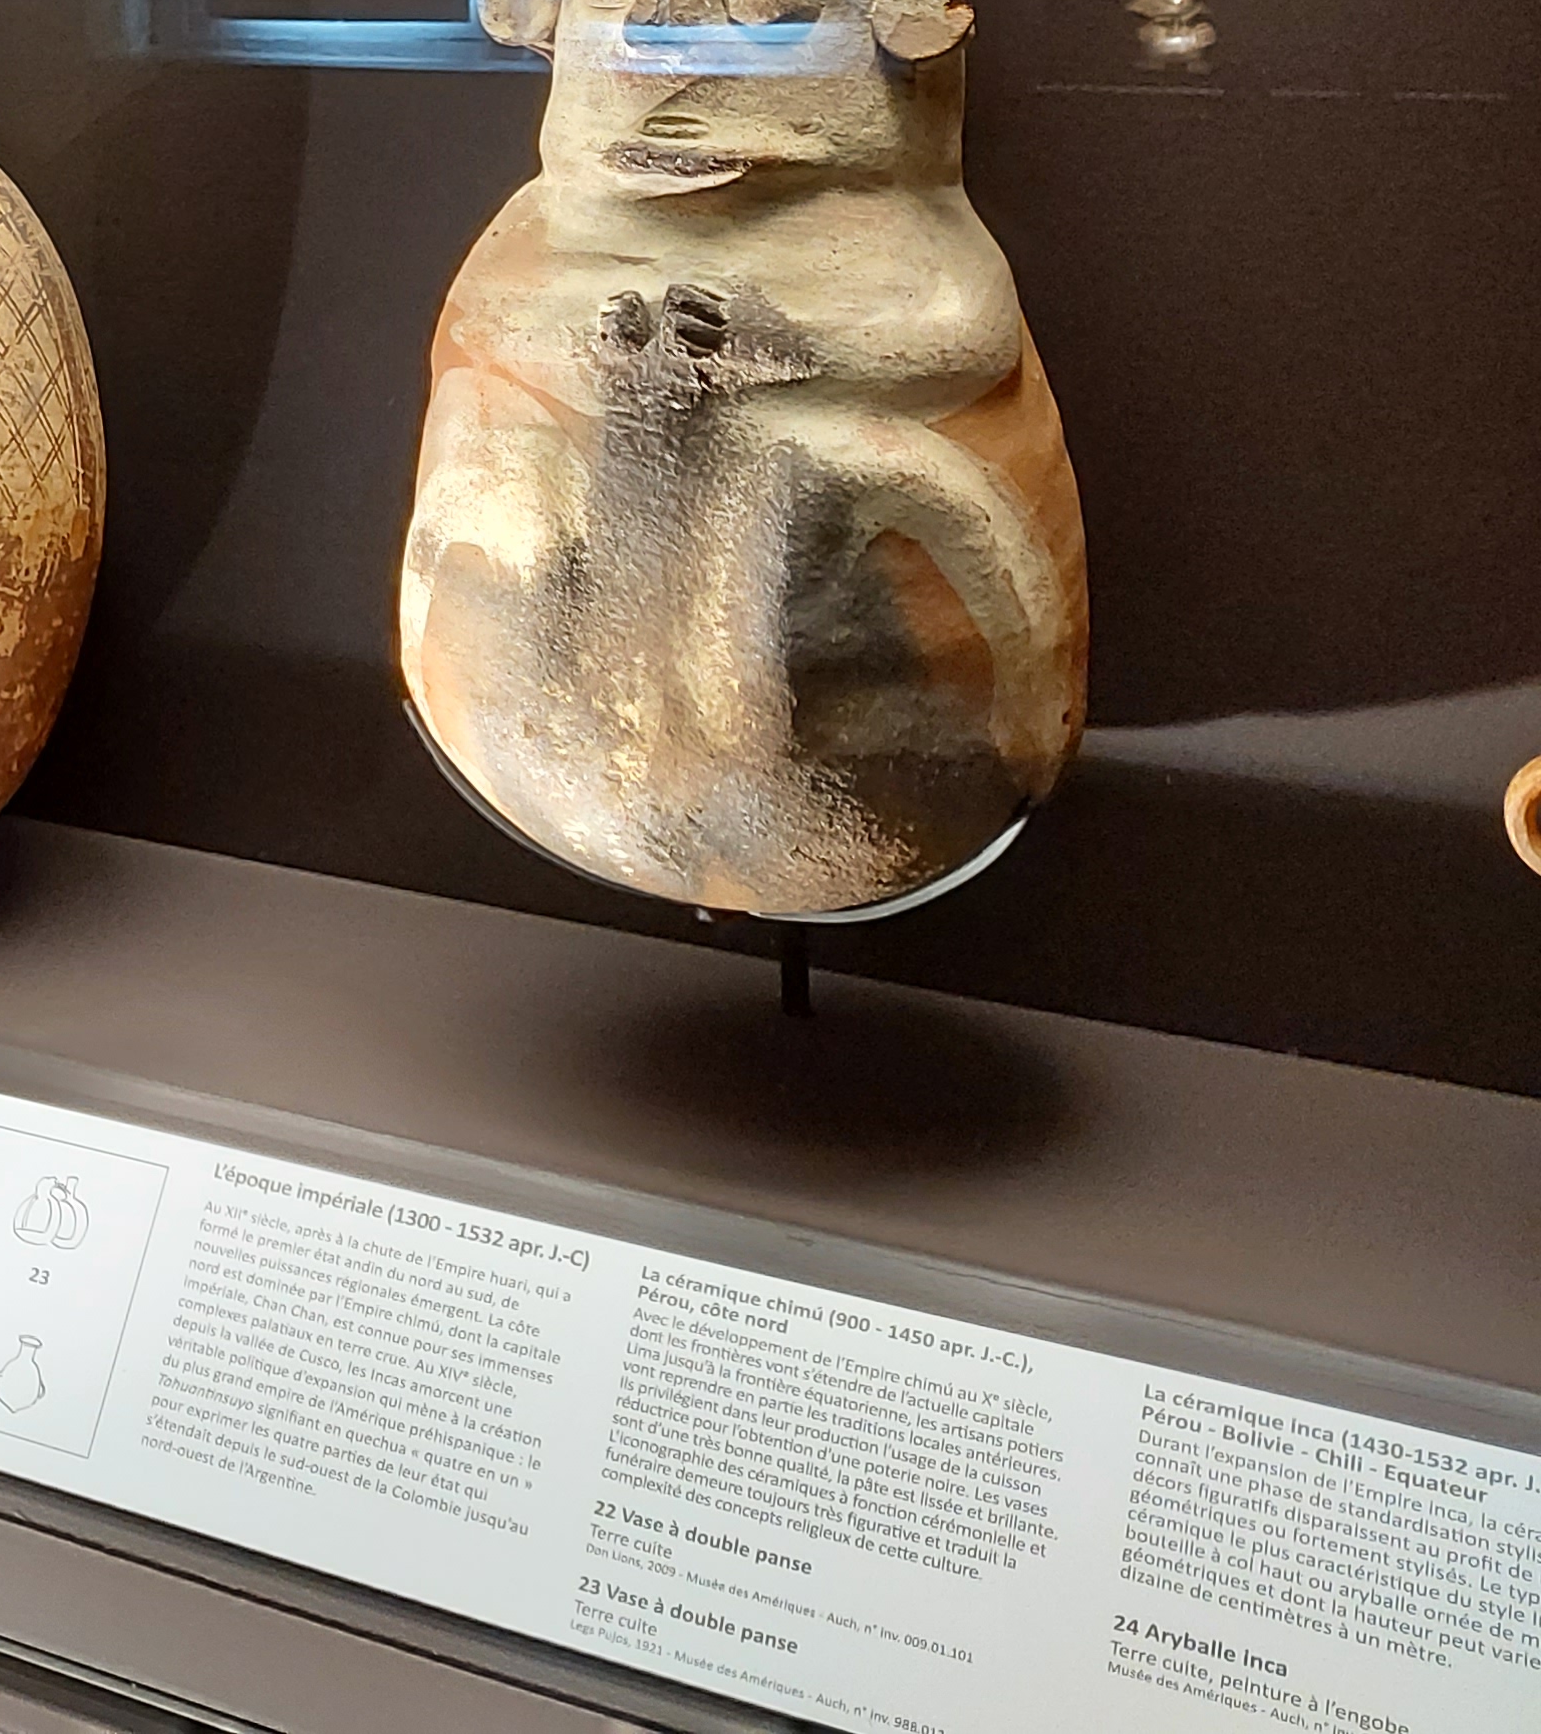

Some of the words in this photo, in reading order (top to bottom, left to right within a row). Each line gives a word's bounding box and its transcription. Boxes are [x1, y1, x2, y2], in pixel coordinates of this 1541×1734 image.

[213, 1162, 293, 1197] L'époque
[295, 1181, 384, 1219] impériale
[386, 1203, 442, 1232] (1300
[455, 1221, 505, 1248] 1532
[507, 1237, 545, 1259] apr.
[29, 1268, 50, 1285] 23
[636, 1284, 695, 1315] Pérou,
[699, 1301, 740, 1323] côte
[743, 1313, 789, 1335] nord
[640, 1264, 661, 1283] La
[664, 1273, 762, 1307] céramique
[765, 1295, 824, 1323] chimú
[828, 1308, 871, 1333] (900
[886, 1324, 935, 1348] 1450
[938, 1338, 976, 1359] apr.
[183, 1274, 249, 1306] impériale,
[252, 1293, 287, 1315] Chan
[289, 1303, 329, 1328] Chan,
[332, 1317, 355, 1333] est
[356, 1323, 410, 1347] connue
[411, 1337, 450, 1357] pour
[449, 1348, 476, 1364] ses
[477, 1352, 554, 1385] immenses
[140, 1434, 215, 1467] nord-ouest
[216, 1455, 236, 1473] de
[237, 1460, 317, 1497] l'Argentine.
[145, 1413, 213, 1444] s'étendait
[213, 1433, 261, 1458] depuis
[262, 1445, 277, 1463] le
[278, 1453, 350, 1485] sud-ouest
[351, 1473, 372, 1491] de
[374, 1478, 388, 1495] la
[390, 1484, 462, 1517] Colombie
[462, 1504, 529, 1537] jusqu'au
[1140, 1404, 1202, 1434] Pérou
[1221, 1423, 1295, 1456] Bolivie
[1314, 1447, 1363, 1474] Chili
[1383, 1462, 1489, 1504] Equateur
[1143, 1382, 1166, 1403] La
[1171, 1392, 1285, 1432] céramique
[1290, 1416, 1334, 1444] inca
[1340, 1429, 1469, 1476] (1430-1532
[1474, 1466, 1518, 1489] apr.
[589, 1522, 630, 1548] Terre
[632, 1538, 673, 1560] cuite
[593, 1499, 617, 1520] 22
[621, 1505, 664, 1534] Vase
[667, 1519, 680, 1539] à
[684, 1525, 750, 1558] double
[754, 1547, 813, 1575] panse
[600, 1466, 683, 1499] complexité
[684, 1488, 712, 1507] des
[713, 1498, 783, 1527] concepts
[785, 1517, 852, 1546] religieux
[853, 1534, 876, 1552] de
[877, 1542, 919, 1564] cette
[921, 1554, 983, 1581] culture.
[1112, 1614, 1140, 1636] 24
[1143, 1623, 1237, 1663] Aryballe
[1242, 1648, 1288, 1678] inca
[1119, 1565, 1185, 1595] dizaine
[1188, 1584, 1213, 1603] de
[1217, 1593, 1333, 1636] centimètres
[1337, 1623, 1349, 1640] à
[1354, 1630, 1381, 1649] un
[1385, 1637, 1452, 1669] mètre.
[1110, 1639, 1158, 1667] Terre
[1161, 1657, 1214, 1686] cuite,
[1219, 1673, 1302, 1708] peinture
[1307, 1695, 1319, 1712] à
